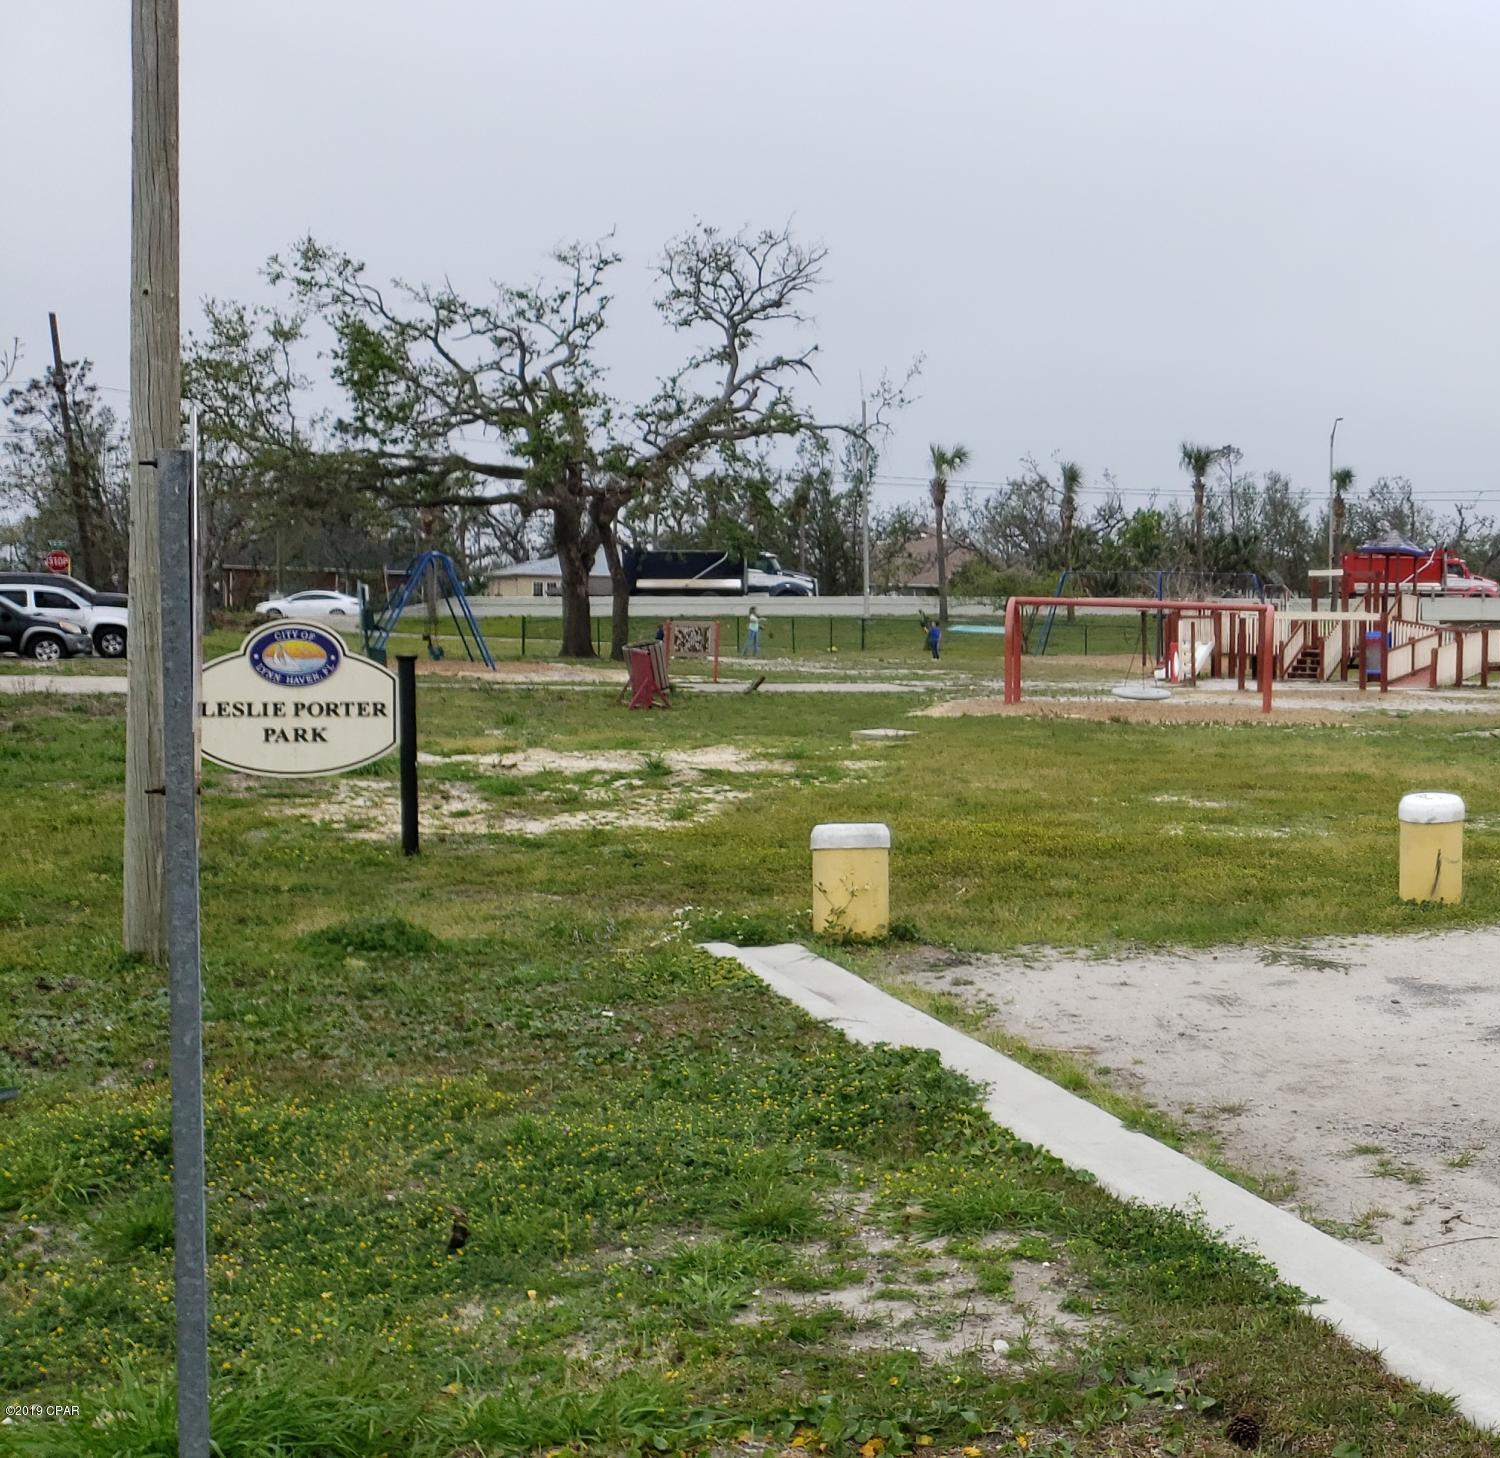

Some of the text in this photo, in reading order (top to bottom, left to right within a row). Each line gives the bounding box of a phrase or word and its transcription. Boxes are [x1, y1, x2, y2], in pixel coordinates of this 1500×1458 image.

[48, 556, 68, 566] STOP
[274, 629, 316, 640] CITY OF
[255, 662, 281, 682] LYNN
[321, 663, 336, 676] FL
[201, 701, 388, 718] LESLIE PORTER
[262, 727, 328, 743] PARK
